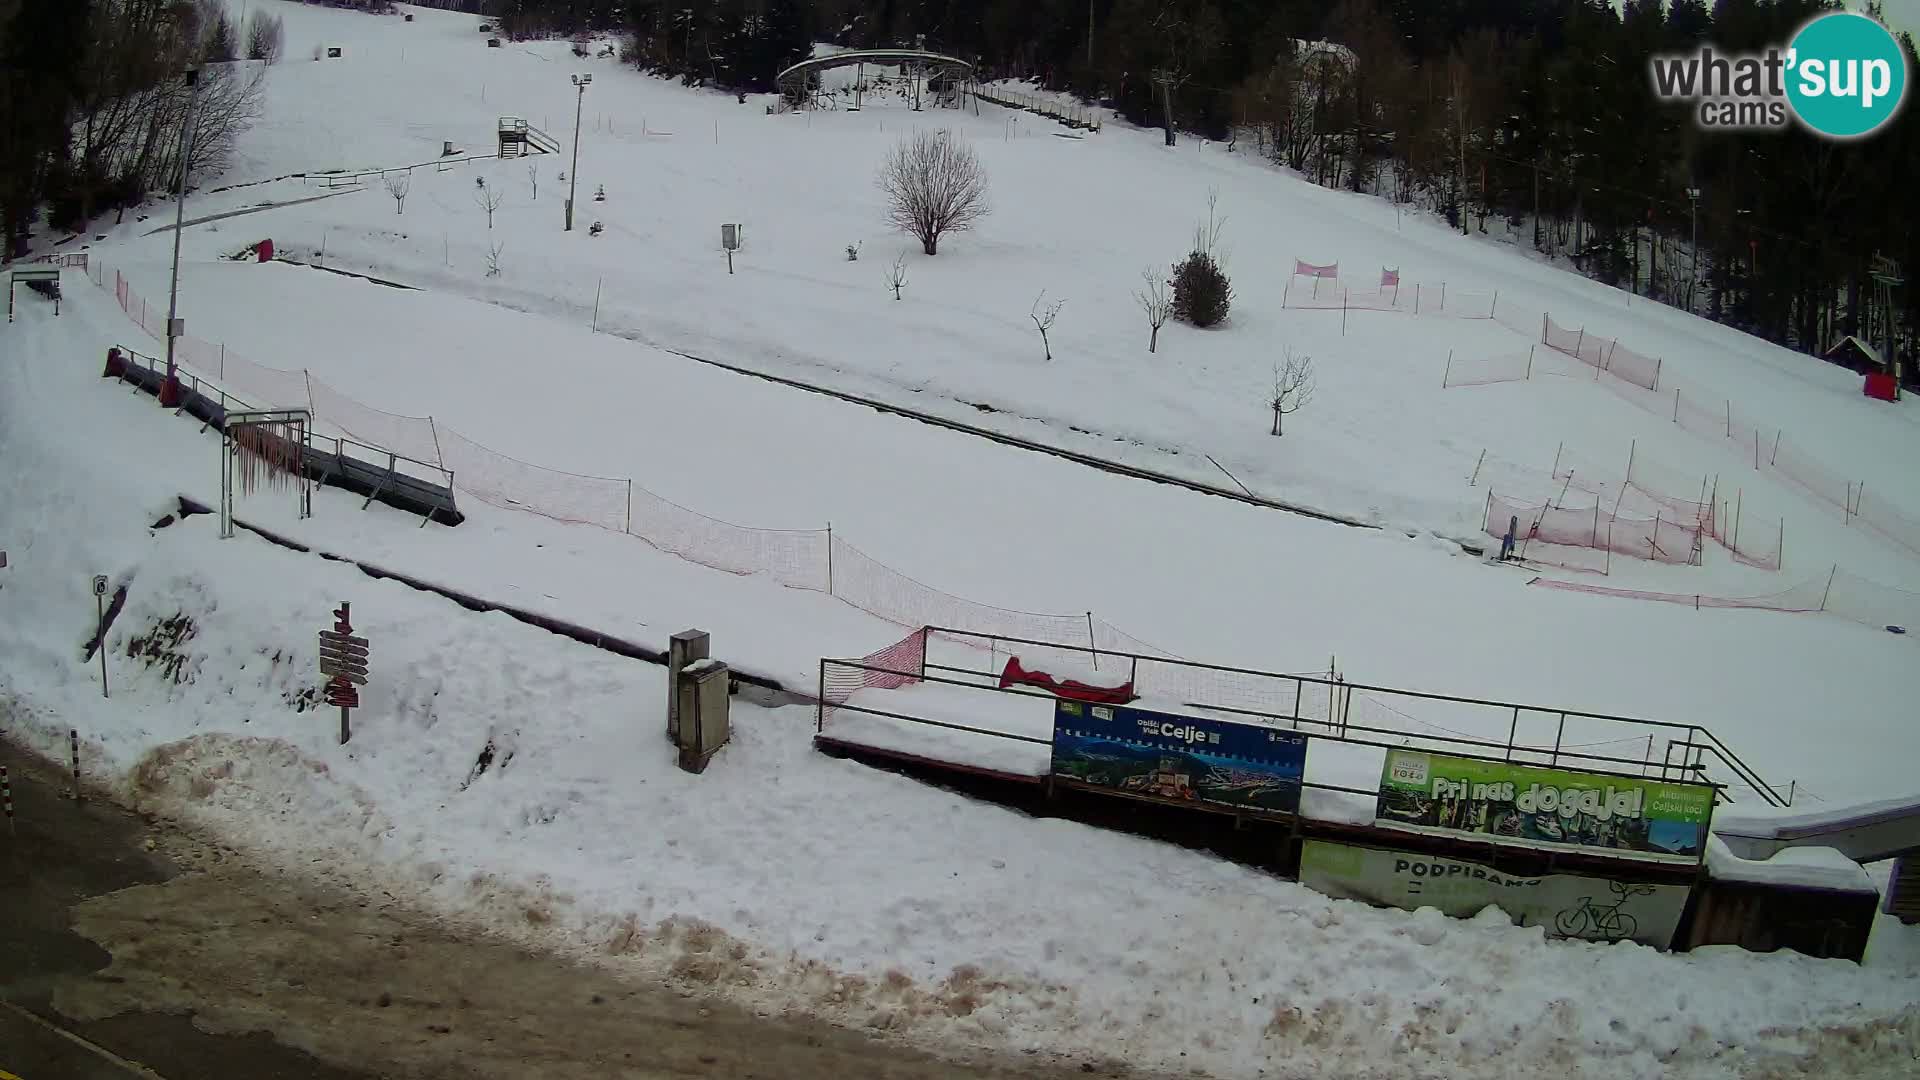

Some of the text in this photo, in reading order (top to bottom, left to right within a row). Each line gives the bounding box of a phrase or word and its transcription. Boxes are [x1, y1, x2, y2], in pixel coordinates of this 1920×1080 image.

[1161, 723, 1206, 744] Celje
[1432, 777, 1468, 800] Pri
[1472, 781, 1514, 802] nas
